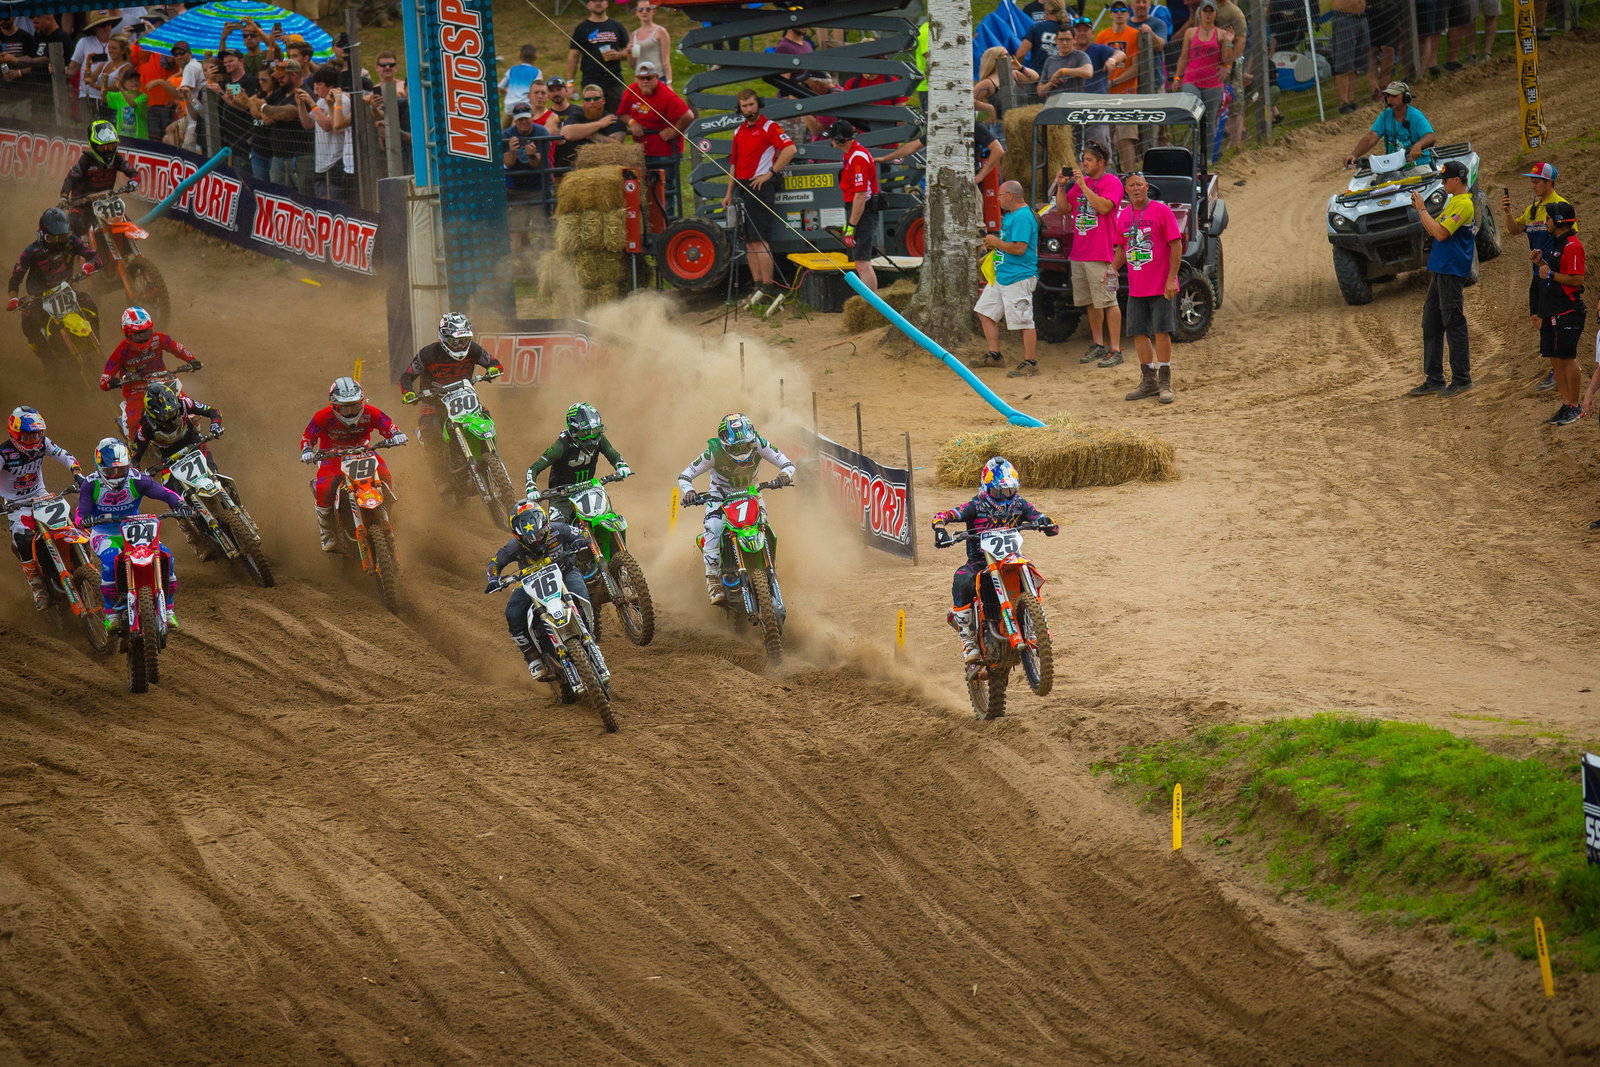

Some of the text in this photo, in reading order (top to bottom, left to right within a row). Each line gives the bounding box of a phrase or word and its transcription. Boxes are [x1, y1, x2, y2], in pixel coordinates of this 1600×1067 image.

[1067, 108, 1167, 125] alpinestars
[785, 174, 834, 190] 10818391
[782, 193, 810, 201] Rentals
[449, 394, 476, 417] 80
[180, 456, 206, 482] 21
[345, 457, 377, 480] 19
[44, 502, 67, 526] 2
[97, 503, 135, 513] HONDA
[735, 500, 750, 523] 1
[126, 524, 155, 545] 94
[989, 535, 1019, 557] 25
[530, 571, 560, 601] 16
